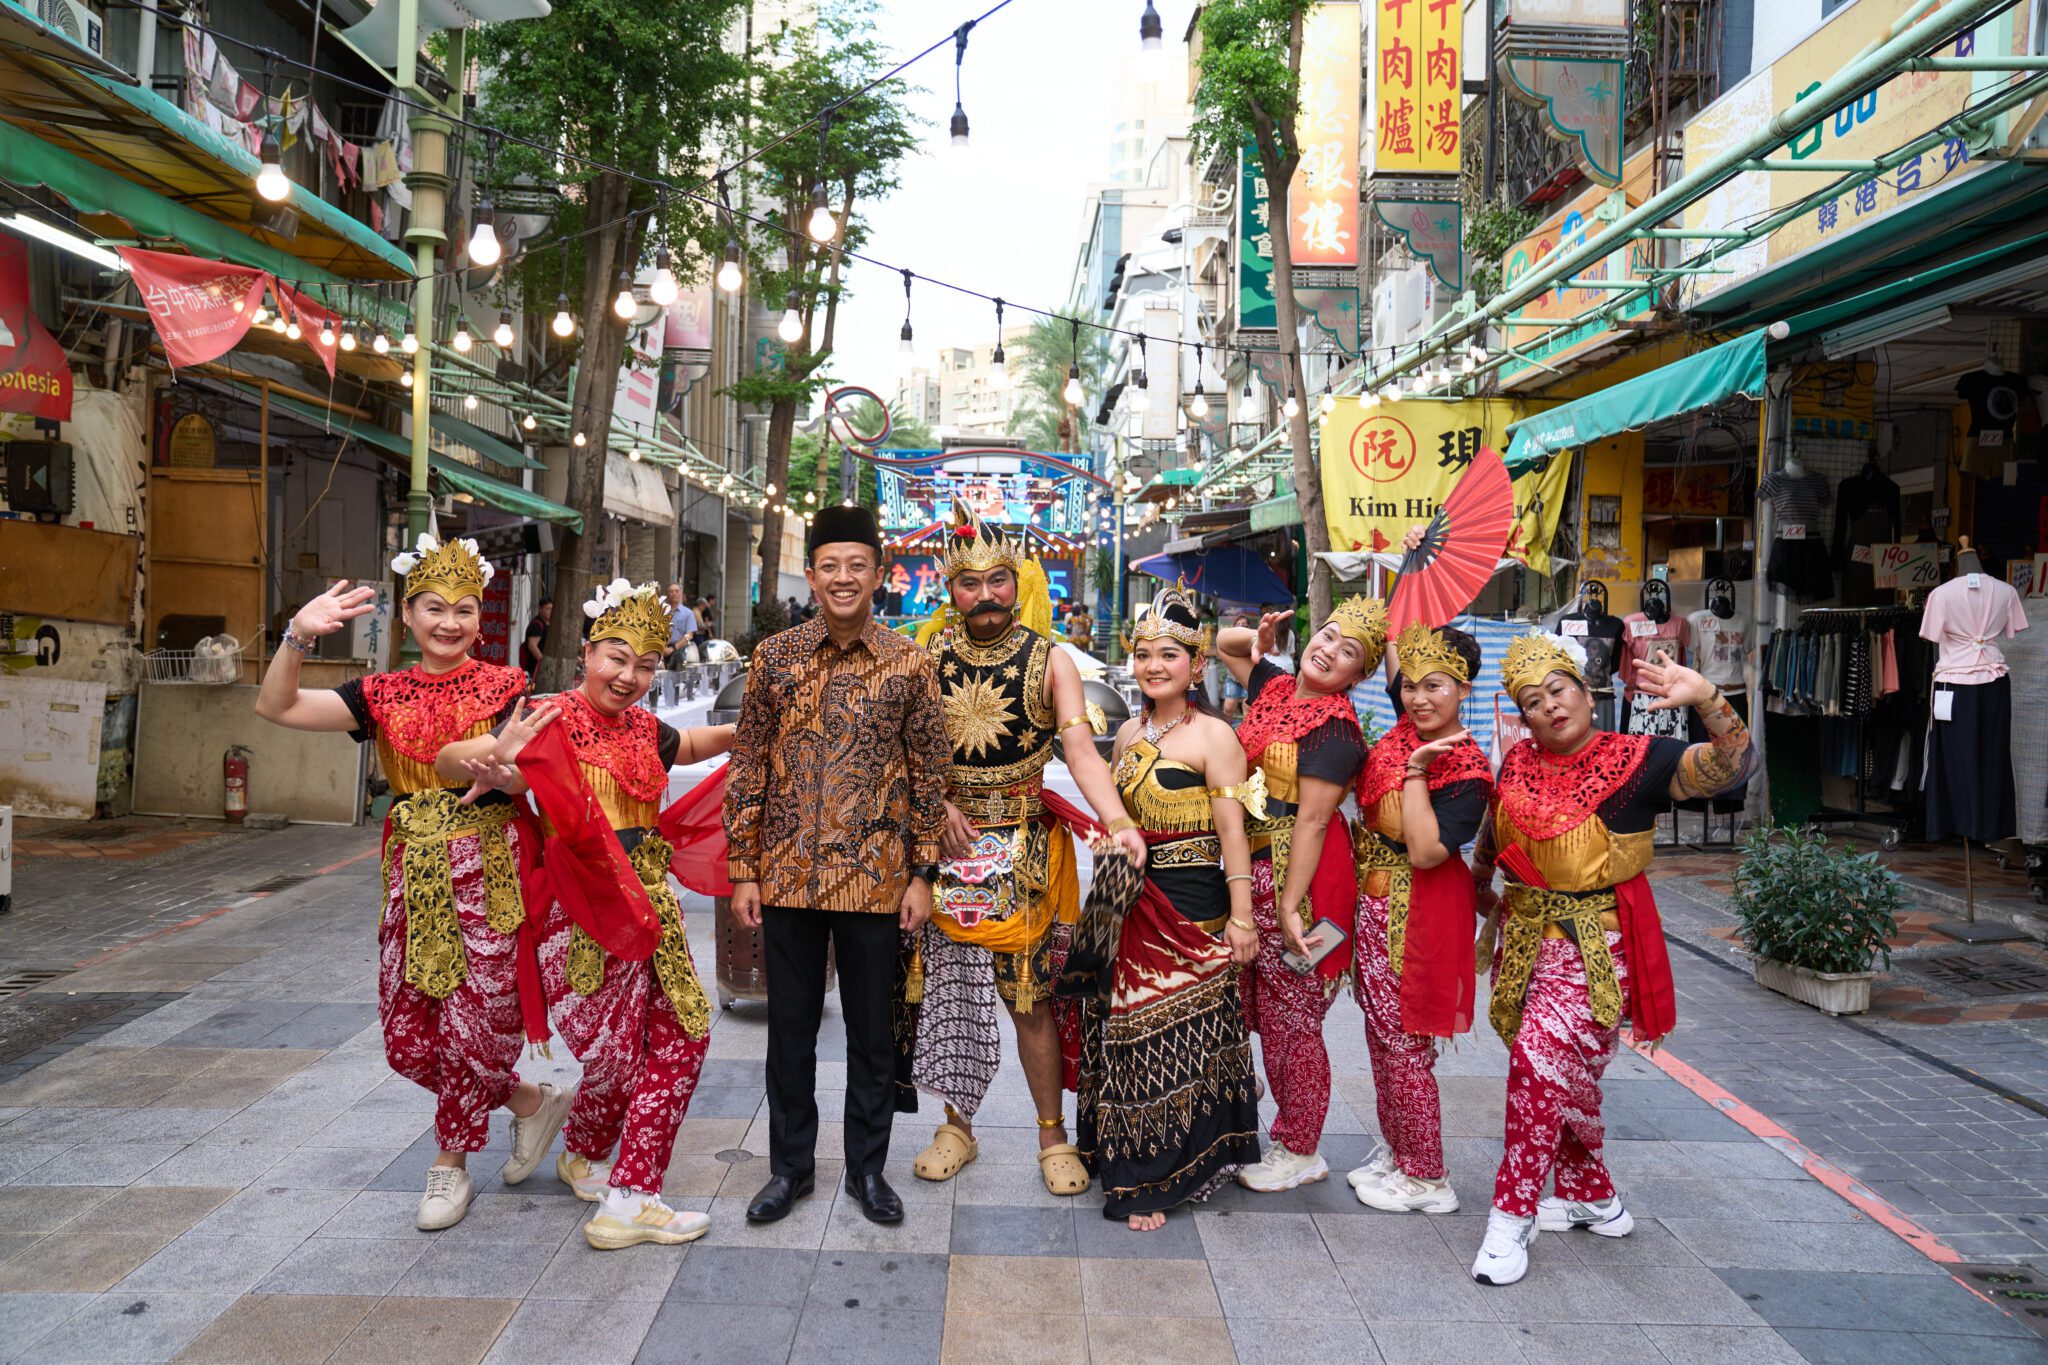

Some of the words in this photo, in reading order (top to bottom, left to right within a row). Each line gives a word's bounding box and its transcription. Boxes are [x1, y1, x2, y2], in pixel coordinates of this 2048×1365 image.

[0, 371, 60, 396] onesia
[1363, 429, 1406, 470] 阮
[1349, 496, 1398, 518] Kim
[1785, 527, 1805, 537] 100
[1881, 545, 1910, 569] 190
[1912, 561, 1938, 584] 290
[1565, 622, 1587, 634] 100
